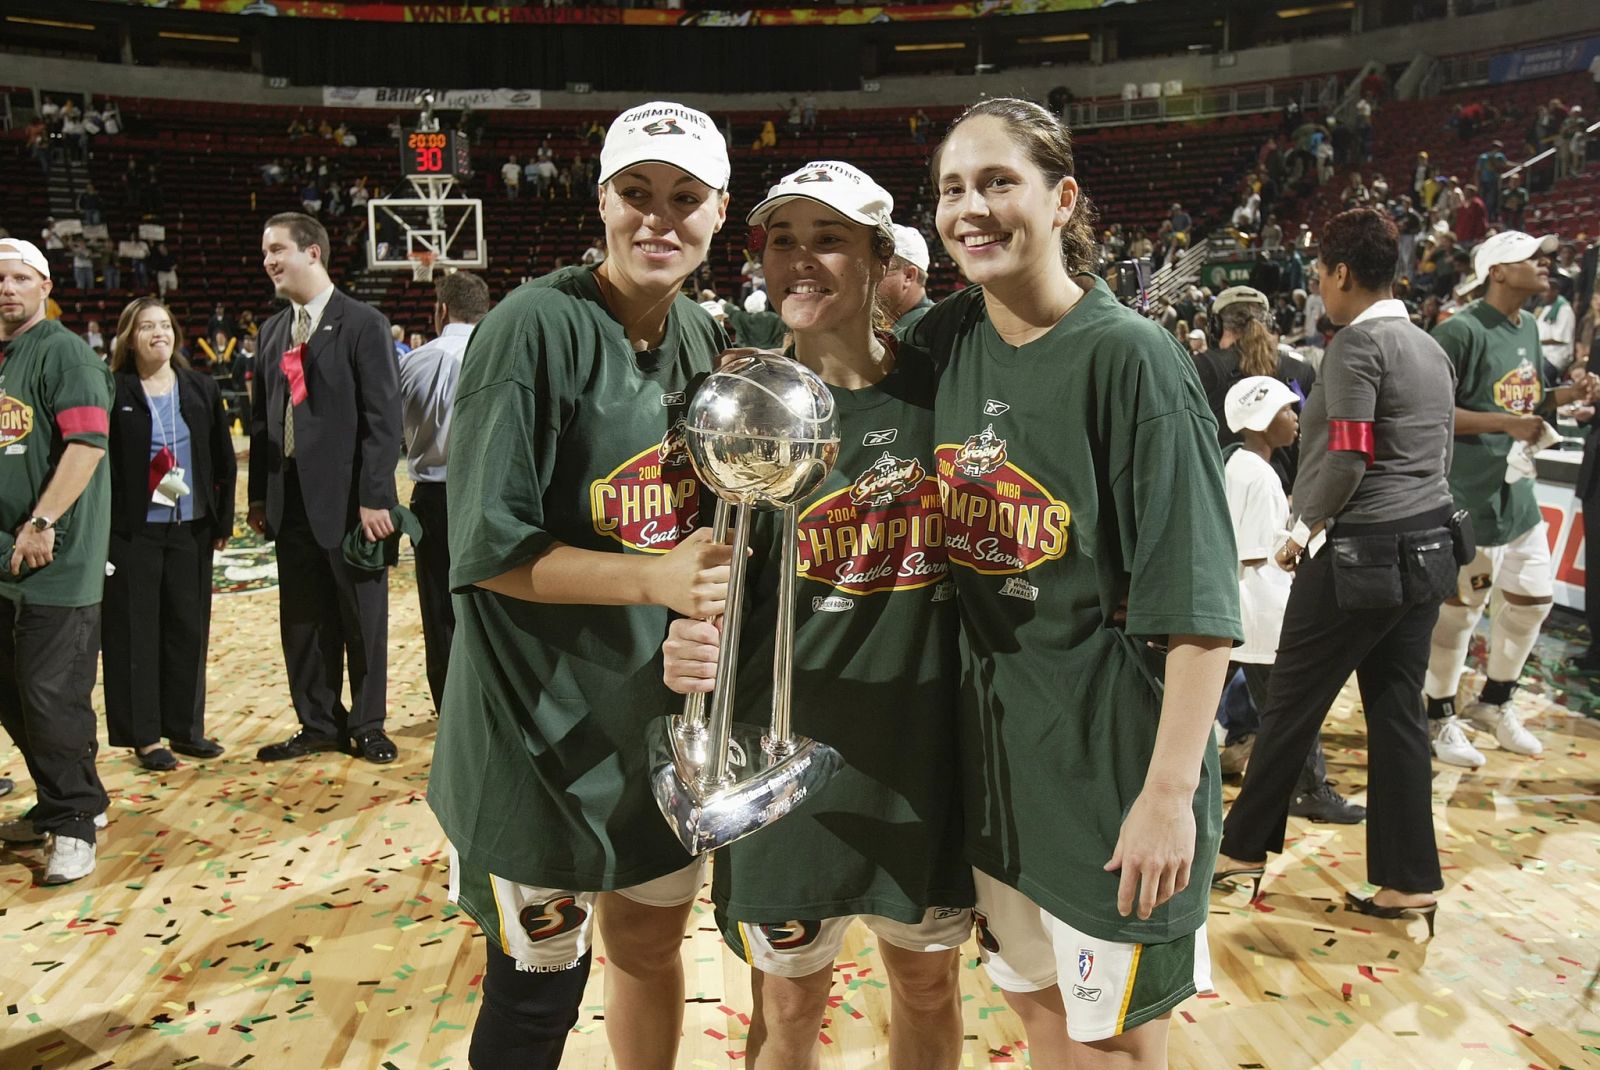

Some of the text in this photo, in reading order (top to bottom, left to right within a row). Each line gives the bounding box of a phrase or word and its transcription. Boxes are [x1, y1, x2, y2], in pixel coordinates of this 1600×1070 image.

[623, 108, 707, 129] CHAMPIONS
[408, 133, 447, 148] 20:00
[416, 147, 442, 172] 30
[639, 465, 661, 480] 2004
[938, 457, 955, 479] 2004
[996, 479, 1021, 500] WNBA
[827, 506, 857, 524] 2004
[973, 537, 1025, 569] Storm
[832, 554, 894, 585] Seattle
